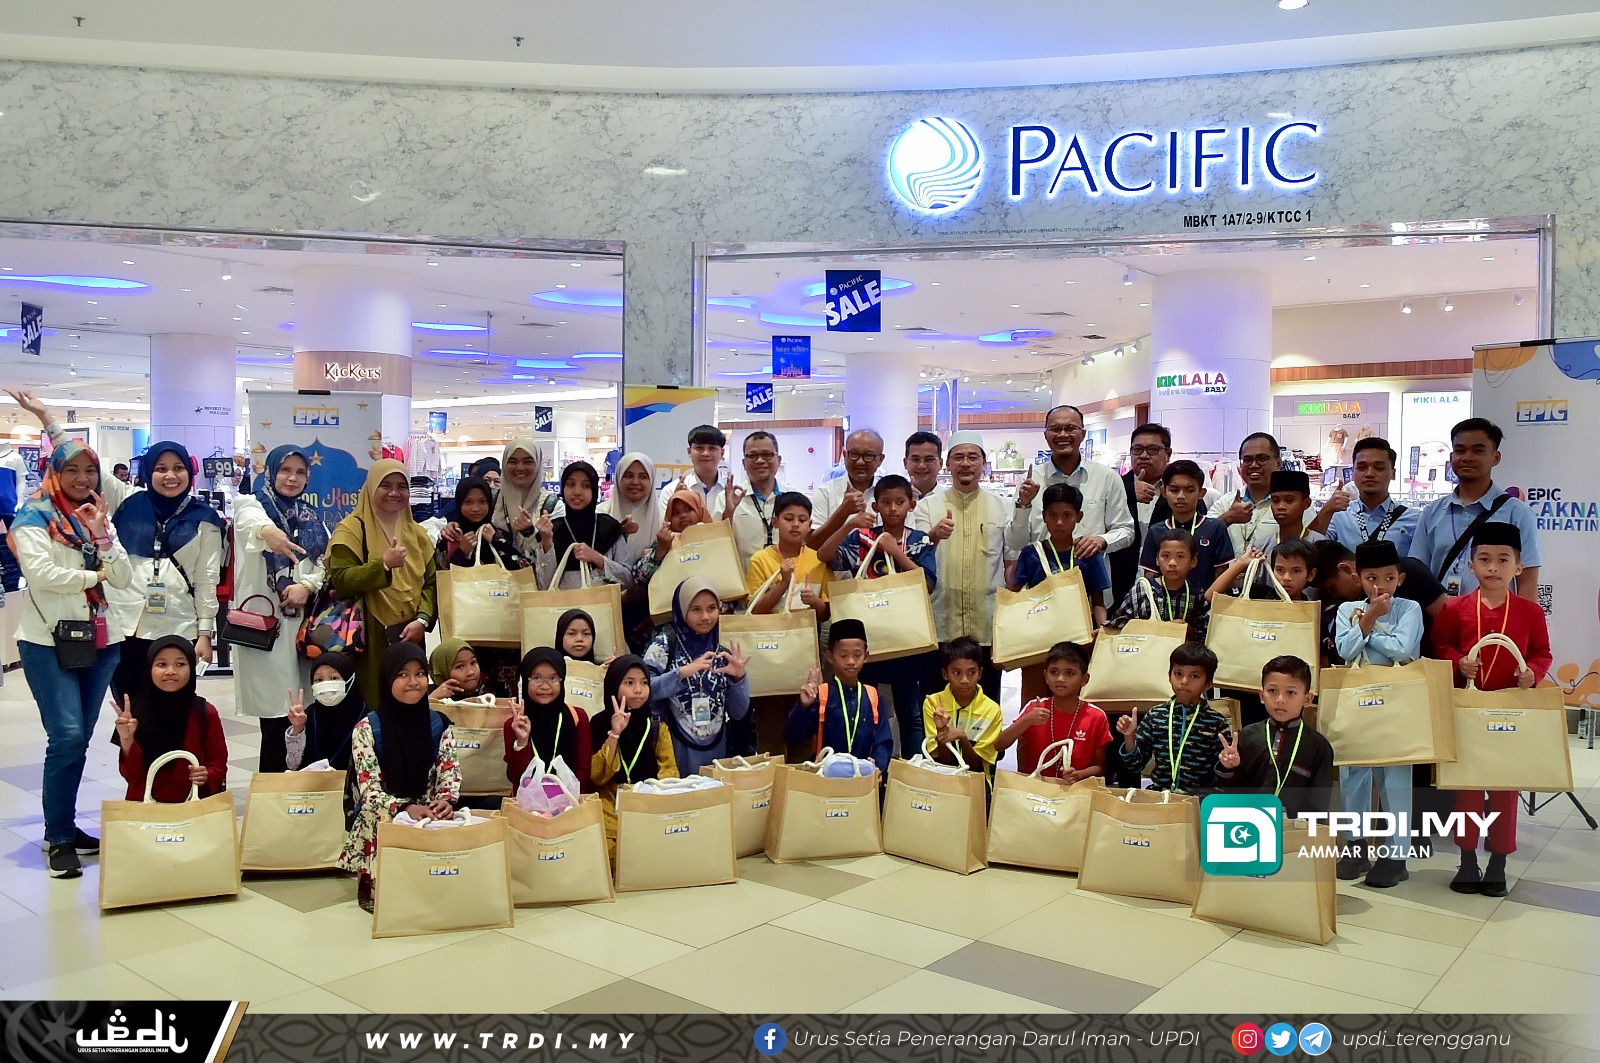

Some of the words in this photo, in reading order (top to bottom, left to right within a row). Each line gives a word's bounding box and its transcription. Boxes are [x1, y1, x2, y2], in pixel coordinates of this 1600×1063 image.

[1010, 121, 1320, 198] PACIFIC
[1183, 214, 1217, 228] MBKT
[1221, 210, 1302, 226] 1A7/2-9/KTCC
[1305, 209, 1311, 222] 1
[838, 274, 865, 291] PACIFIC
[826, 280, 881, 326] SALE
[22, 315, 43, 350] SALE
[1156, 372, 1227, 388] KIKILALA
[746, 387, 774, 411] SALE
[1413, 395, 1459, 404] KIKILALA
[1298, 401, 1361, 415] KIKILALA
[1517, 402, 1566, 421] EPIC
[293, 407, 339, 426] EPIC
[534, 412, 553, 430] SALE
[26, 450, 39, 461] 73
[215, 461, 232, 476] 99
[547, 484, 561, 495] 59
[1527, 488, 1561, 501] EPIC
[1537, 518, 1599, 532] RIHATIN
[1252, 630, 1276, 641] EPIC
[1117, 643, 1140, 653] EPIC
[1359, 695, 1384, 707] EPIC
[1487, 720, 1516, 731] EPIC
[456, 738, 480, 749] EPIC
[288, 803, 314, 814] EPIC
[825, 808, 849, 818] EPIC
[665, 821, 689, 835] EPIC
[156, 832, 185, 843] EPIC
[1123, 835, 1150, 847] EPIC
[538, 849, 564, 861] EPIC
[429, 864, 459, 876] EPIC
